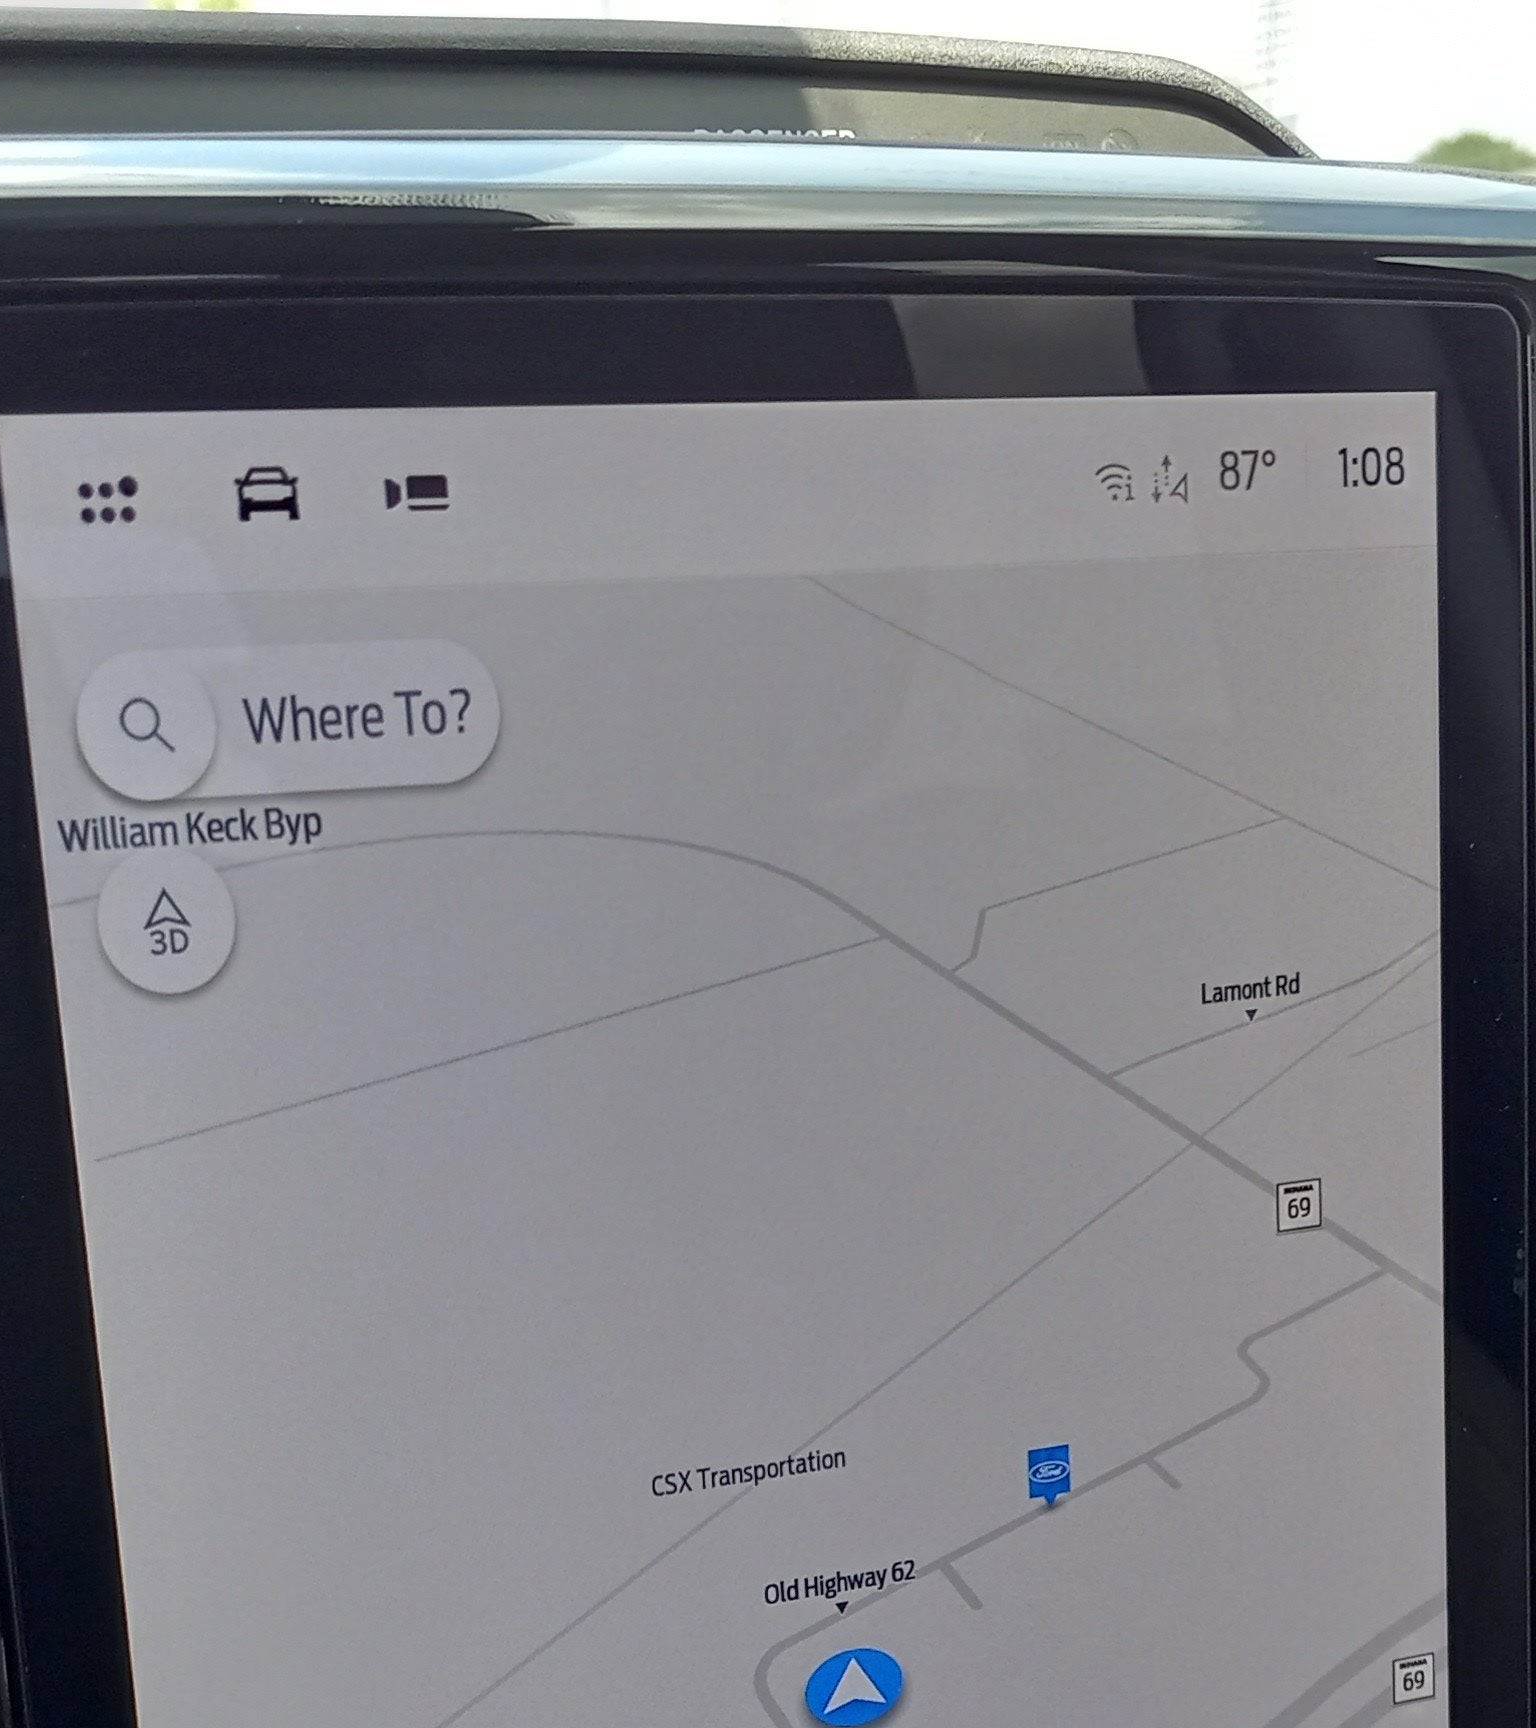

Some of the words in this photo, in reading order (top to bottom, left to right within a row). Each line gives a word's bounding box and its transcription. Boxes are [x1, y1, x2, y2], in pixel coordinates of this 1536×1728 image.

[1219, 450, 1276, 491] 87°
[1338, 446, 1405, 488] 1:08
[241, 694, 385, 744] Where
[393, 688, 472, 735] To?
[57, 815, 179, 853] William
[186, 807, 258, 845] Keck
[264, 806, 323, 844] Byp
[149, 929, 190, 957] 3D
[1201, 976, 1272, 1005] Lamont
[1276, 971, 1301, 998] Rd
[1287, 1196, 1311, 1219] 69
[651, 1470, 693, 1497] CSX
[697, 1449, 846, 1491] Transportation
[764, 1577, 799, 1605] Old
[803, 1565, 888, 1599] Highway
[891, 1559, 917, 1583] 62
[1403, 1670, 1425, 1692] 69
